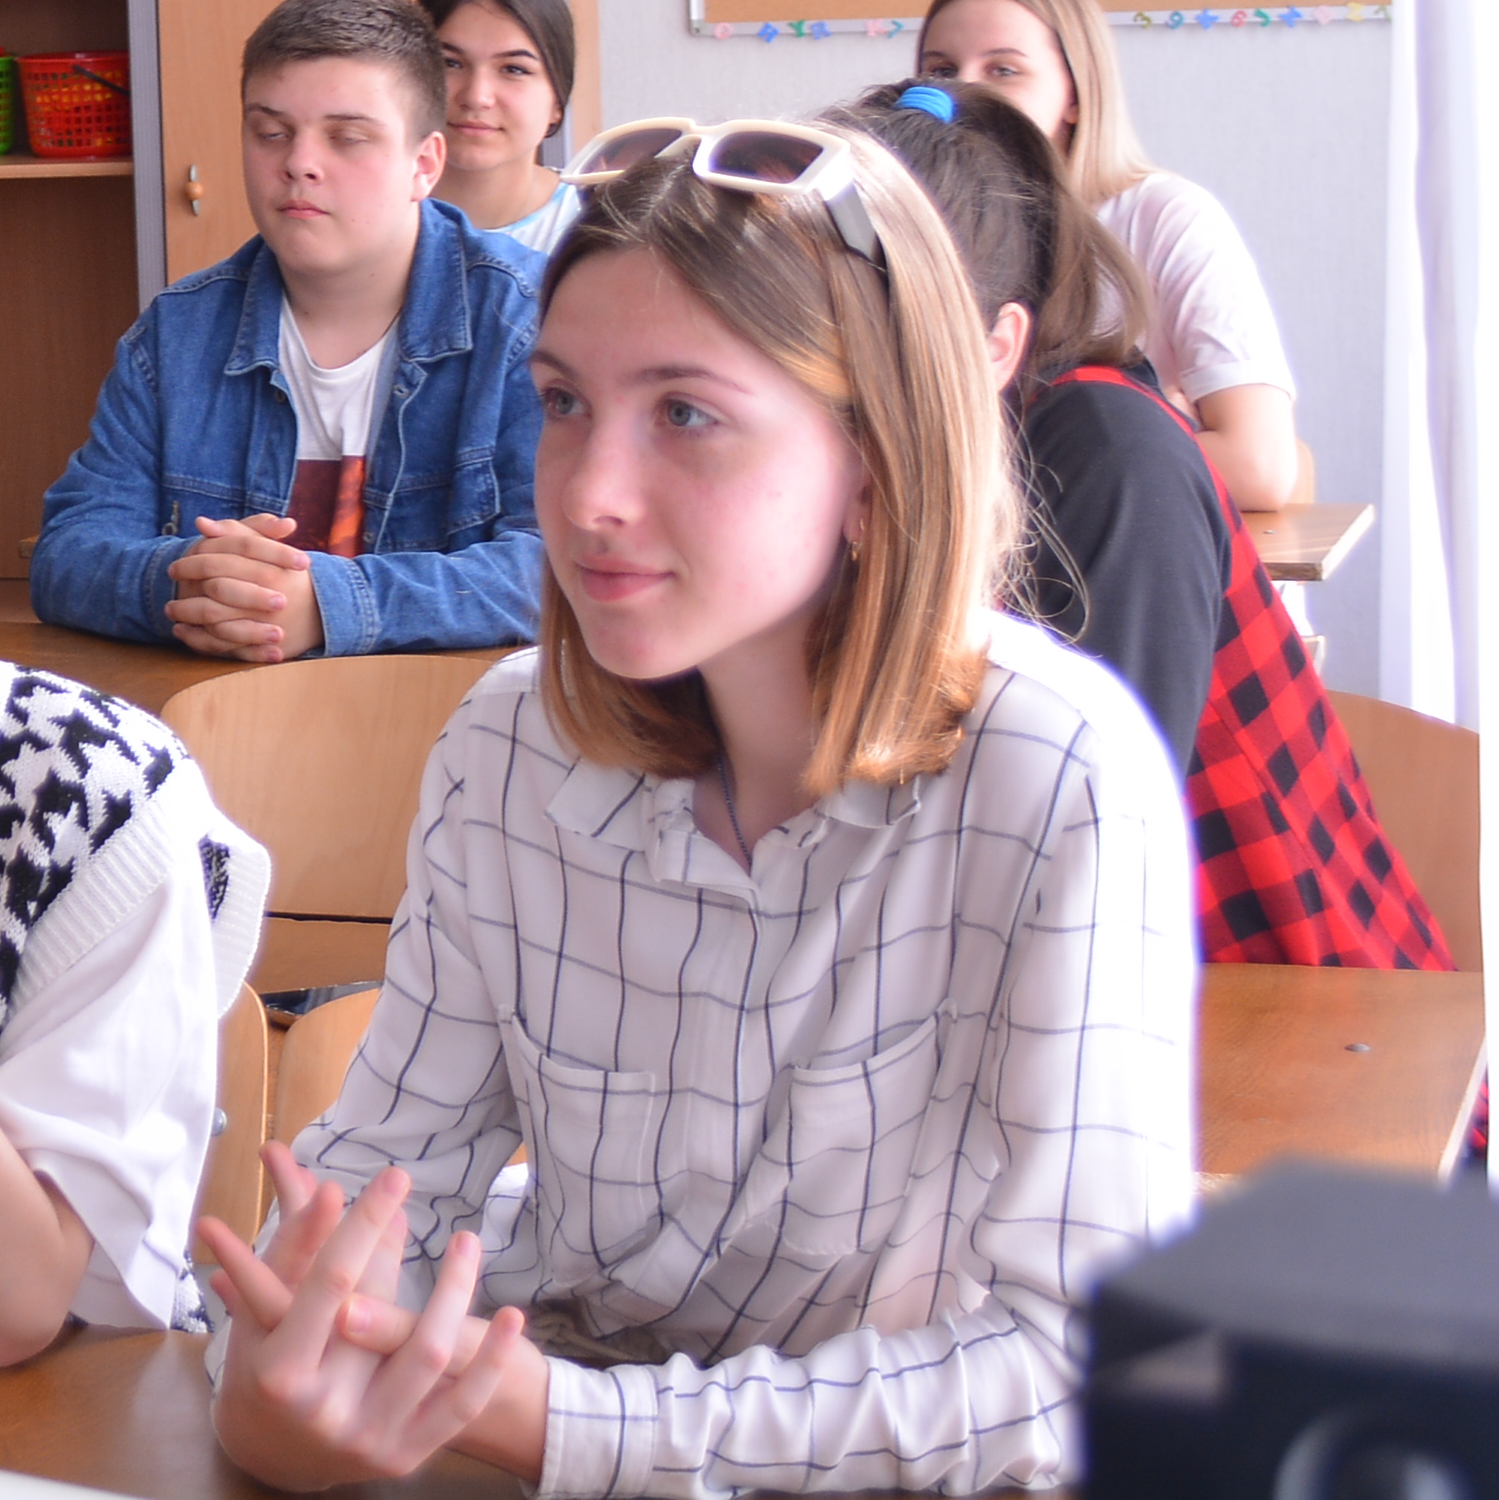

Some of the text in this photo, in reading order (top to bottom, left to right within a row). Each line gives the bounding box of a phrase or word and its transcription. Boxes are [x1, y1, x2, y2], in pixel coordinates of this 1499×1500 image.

[787, 20, 805, 37] Y
[1166, 11, 1183, 29] 9
[1231, 10, 1247, 27] 6
